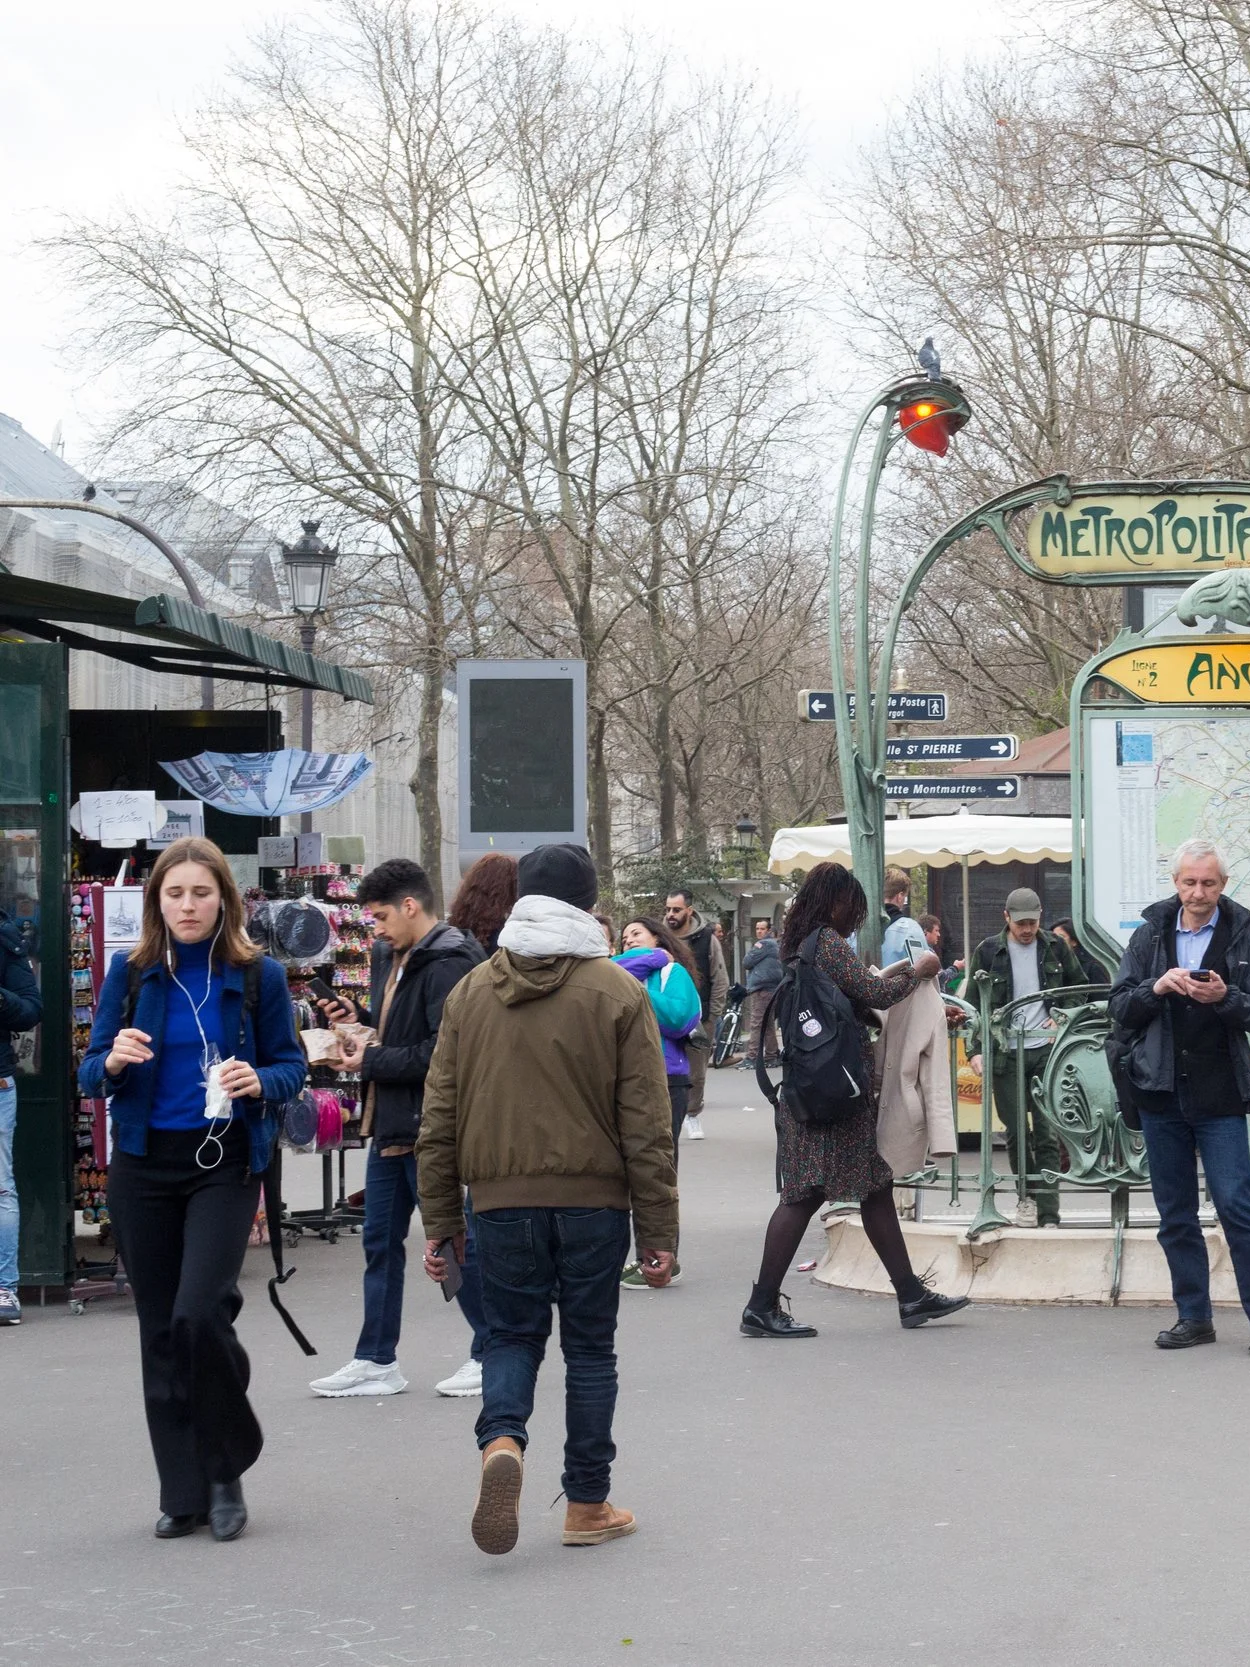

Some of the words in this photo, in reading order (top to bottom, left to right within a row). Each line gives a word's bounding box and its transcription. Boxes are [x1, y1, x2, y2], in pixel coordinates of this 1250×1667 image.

[1149, 672, 1158, 687] 2
[900, 697, 926, 706] Poste
[889, 710, 905, 718] rgot
[887, 745, 901, 754] lle
[922, 744, 962, 754] PIERRE
[887, 785, 909, 794] utte
[913, 784, 976, 794] Montmartre
